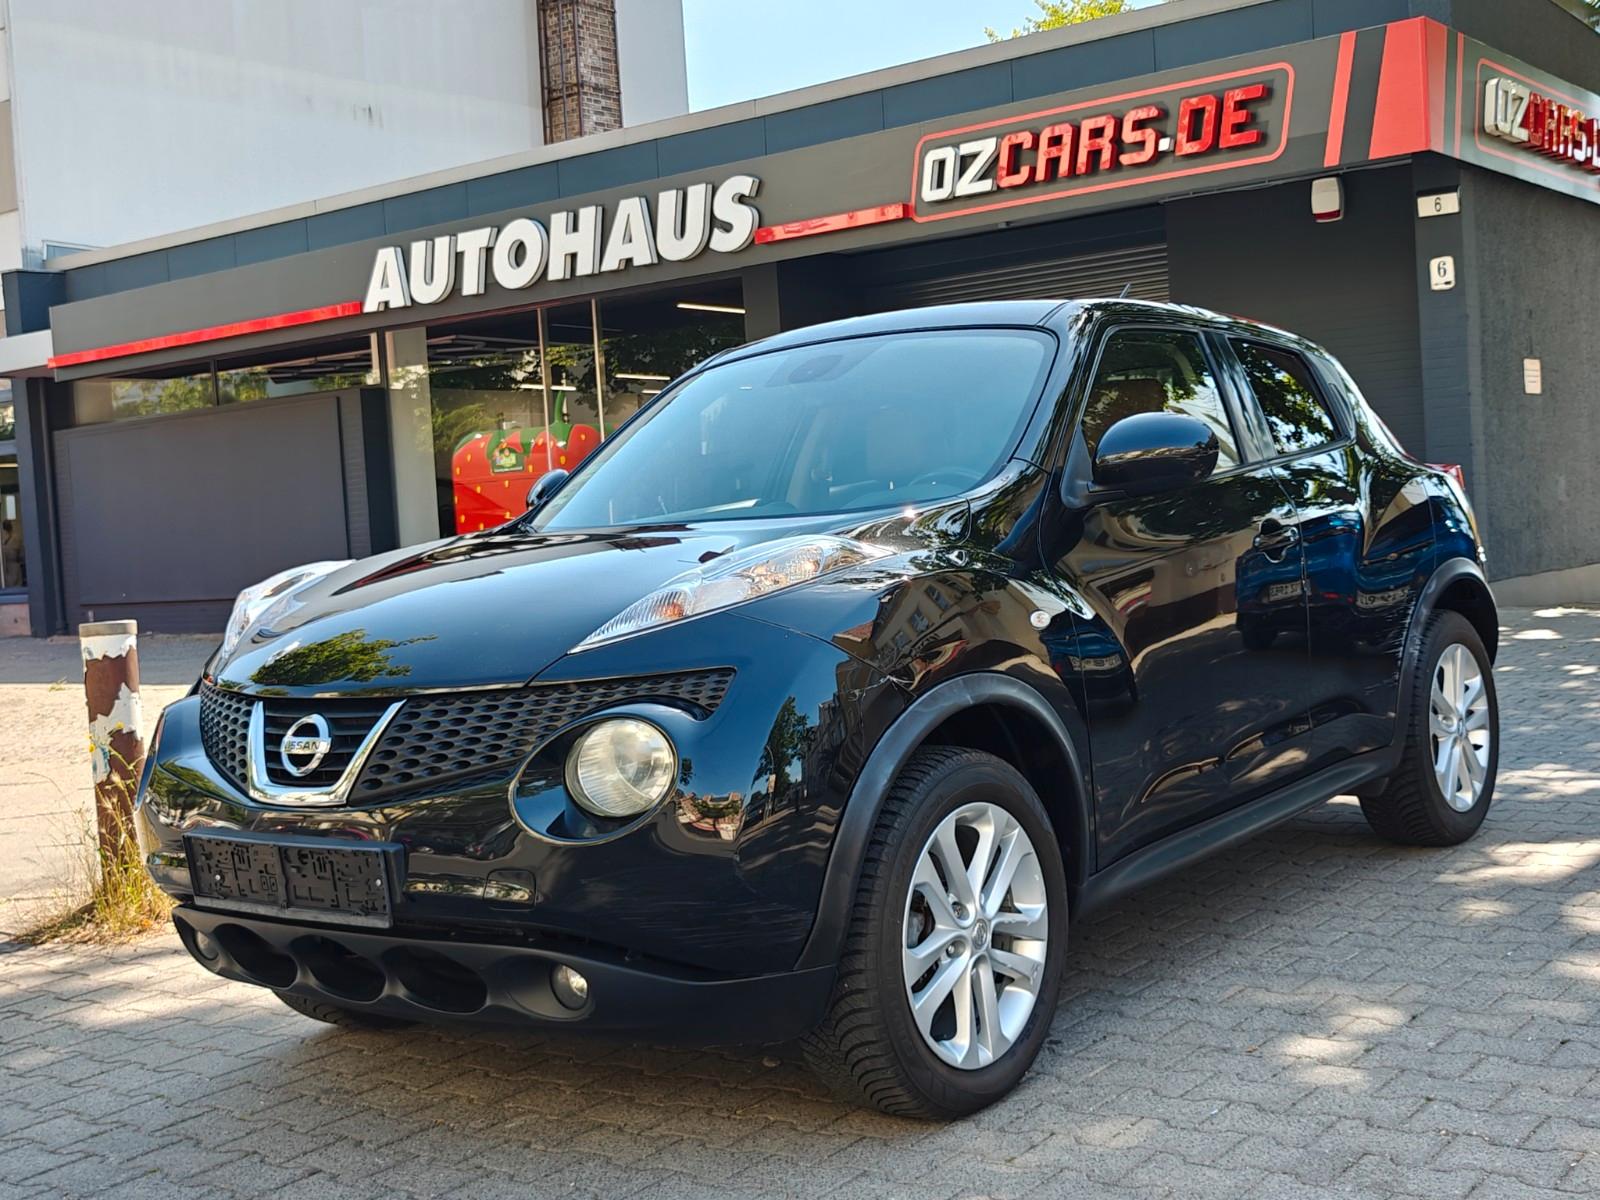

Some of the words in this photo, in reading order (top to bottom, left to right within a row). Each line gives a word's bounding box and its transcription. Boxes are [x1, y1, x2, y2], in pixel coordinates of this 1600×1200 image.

[921, 83, 1269, 203] OZCARS.DE
[1434, 196, 1442, 212] 6
[363, 174, 761, 313] AUTOHAUS
[1437, 260, 1447, 278] 6
